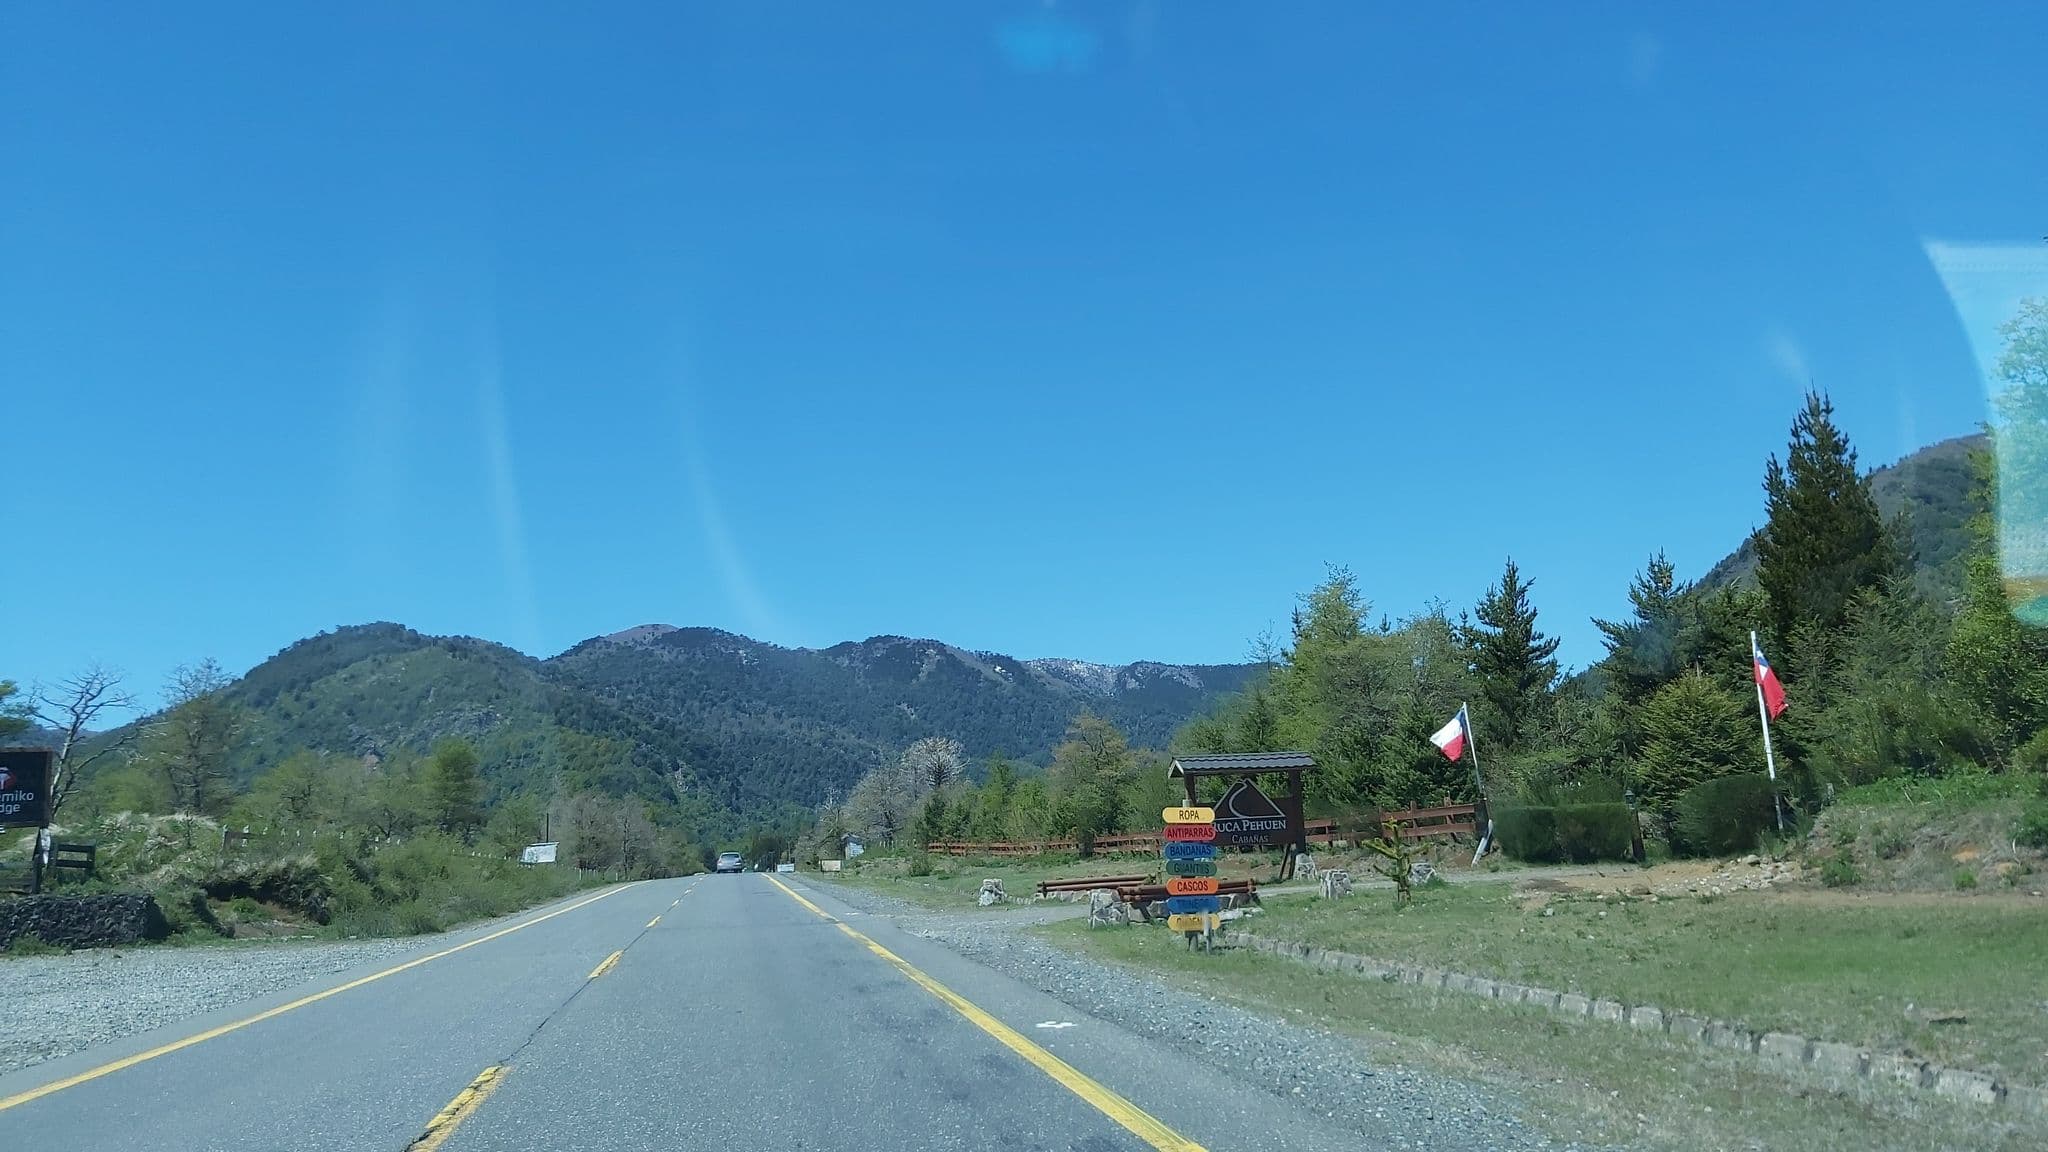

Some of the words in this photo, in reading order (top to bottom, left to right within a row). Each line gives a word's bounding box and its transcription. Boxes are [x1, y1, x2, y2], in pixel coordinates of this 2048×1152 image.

[0, 790, 34, 802] miko
[1179, 810, 1200, 821] ROPA
[1242, 819, 1287, 832] PEHUEN
[1167, 827, 1214, 839] ANTIPARRAS
[1170, 845, 1211, 857] BANDANAS
[1177, 880, 1208, 892] CASCOS
